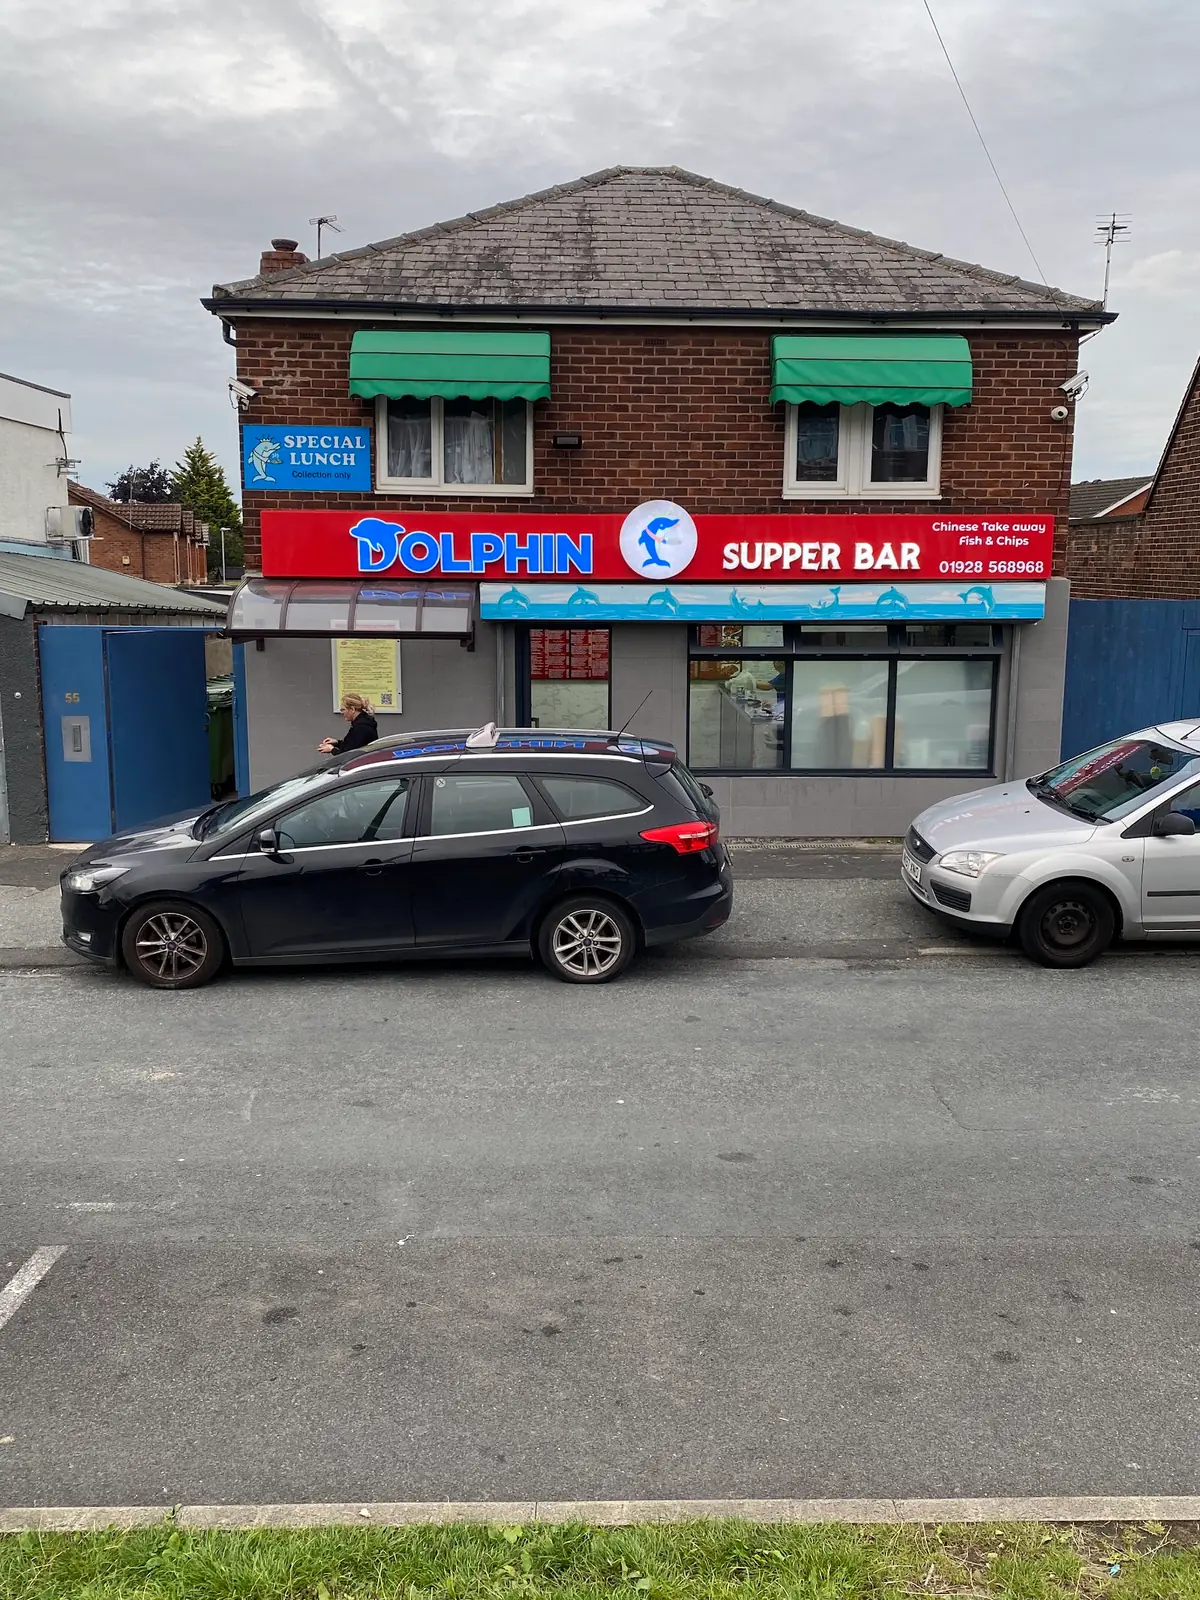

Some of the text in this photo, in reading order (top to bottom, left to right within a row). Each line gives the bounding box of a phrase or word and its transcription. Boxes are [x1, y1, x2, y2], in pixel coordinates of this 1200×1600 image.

[283, 435, 366, 449] SPECIAL
[290, 452, 356, 466] LUNCH
[291, 470, 351, 480] Collection only
[932, 522, 1046, 534] Chinese Take away
[349, 517, 593, 574] DOLPHIN
[959, 535, 1029, 548] Fish & Chips
[722, 541, 921, 571] SUPPER BAR
[939, 560, 1044, 574] 01928 568968
[65, 692, 80, 704] 55
